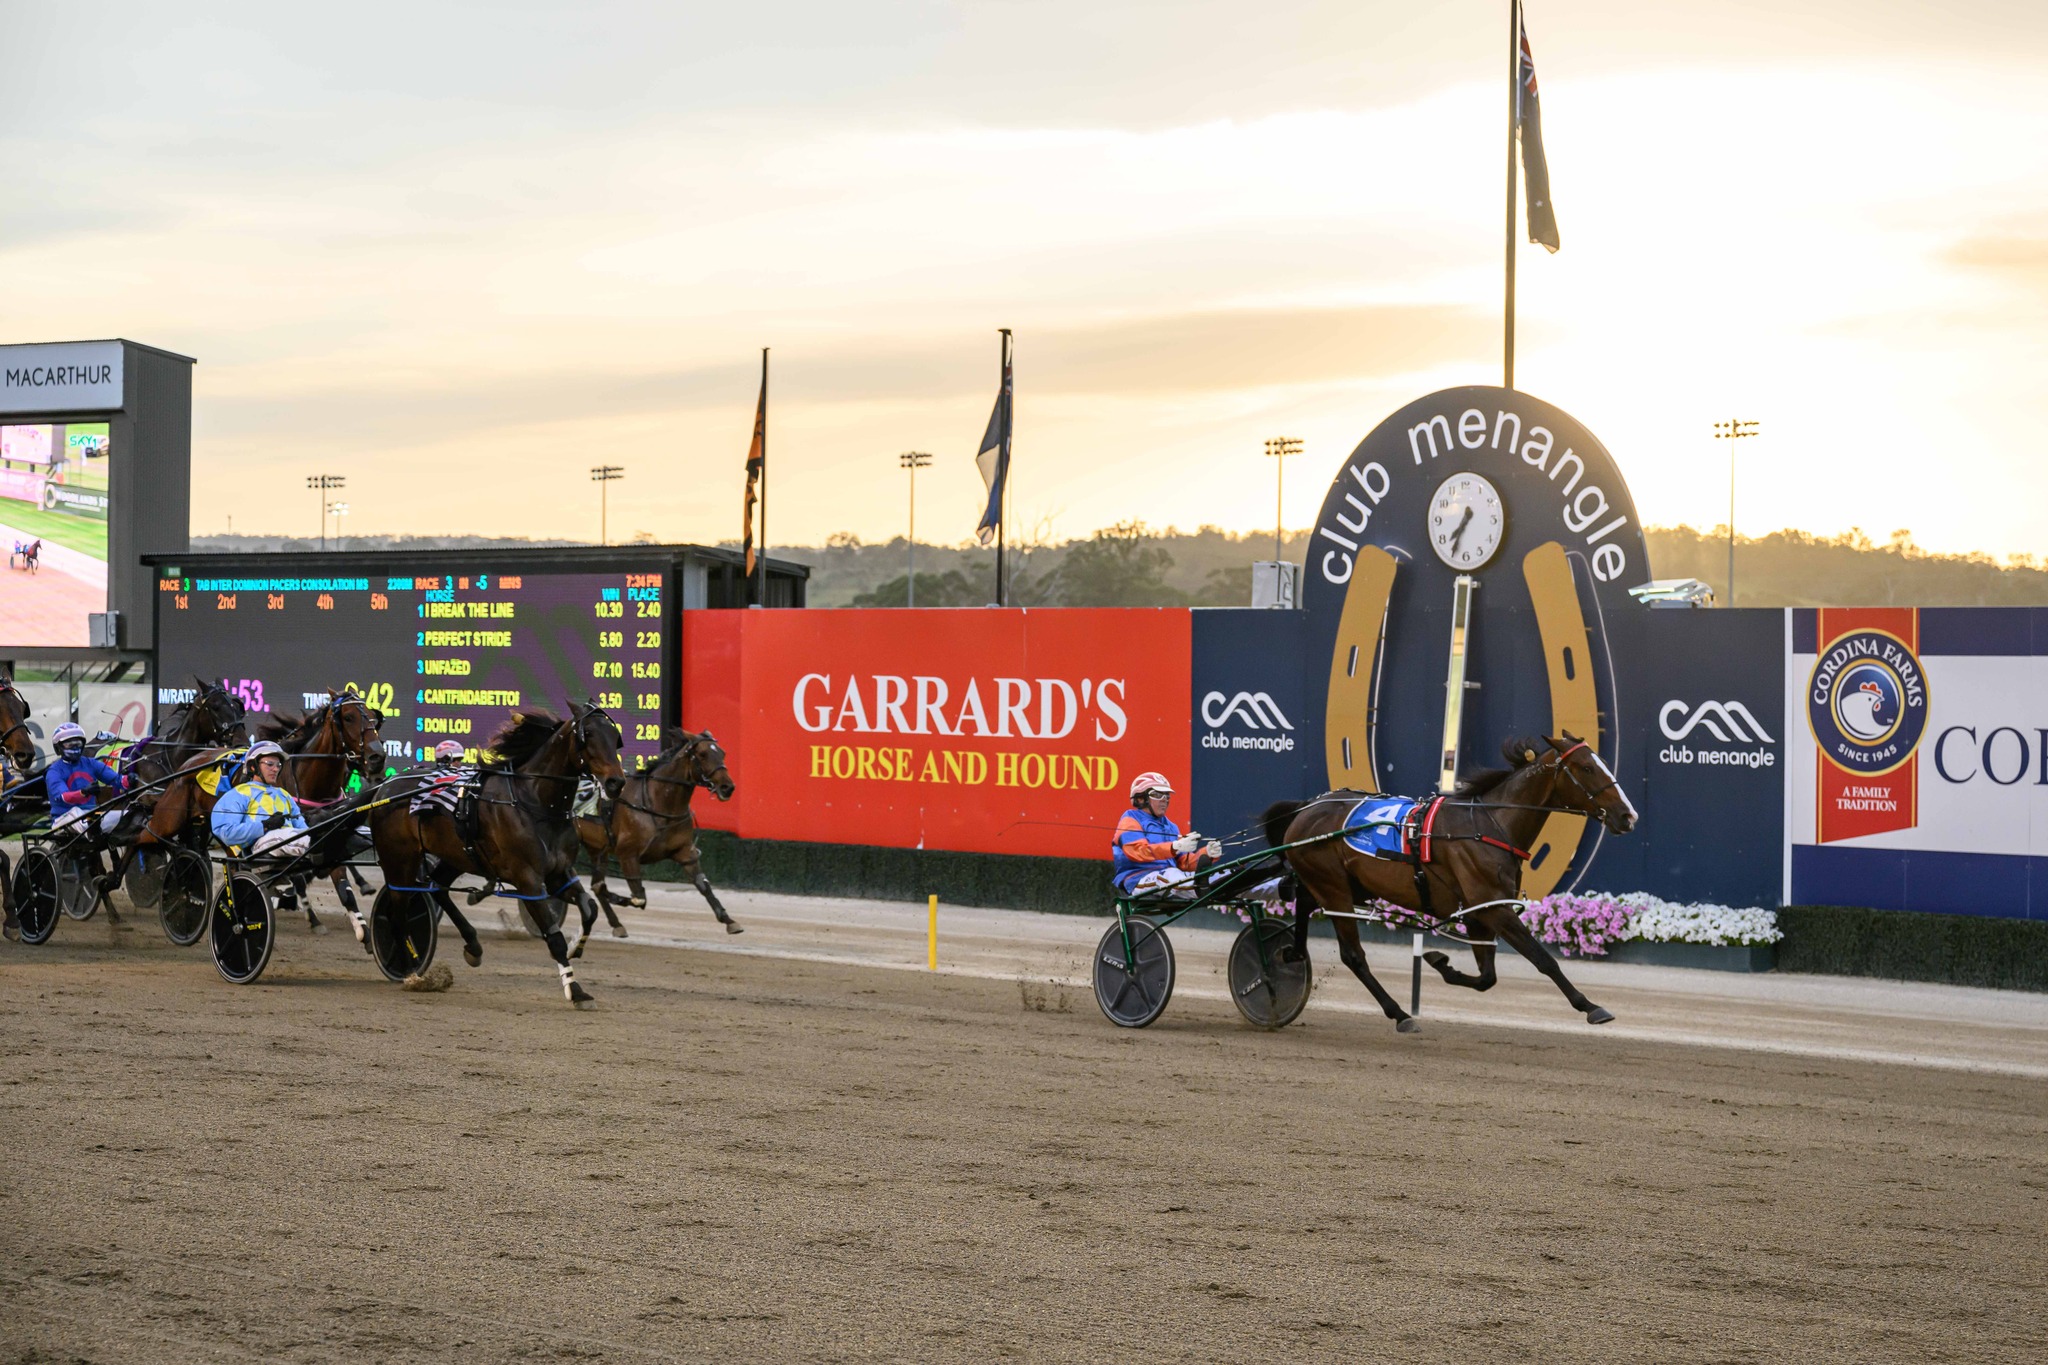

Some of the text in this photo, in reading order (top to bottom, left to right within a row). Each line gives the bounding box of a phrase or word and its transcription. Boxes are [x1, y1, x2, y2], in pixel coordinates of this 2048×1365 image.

[6, 365, 112, 387] MACARTHUR
[1321, 408, 1628, 585] club menangle
[1434, 516, 1442, 526] 9
[1438, 534, 1446, 545] 8
[1462, 551, 1470, 561] 6
[160, 579, 180, 591] RACE
[184, 578, 190, 592] 3
[196, 579, 210, 590] TAB
[210, 579, 232, 591] INTER
[270, 579, 300, 590] PACERS
[301, 578, 355, 590] CONSOLATION
[415, 577, 439, 590] RACE
[445, 576, 453, 590] 3
[475, 575, 488, 590] -5
[174, 594, 389, 609] 1st 2nd 3rd 4th 5th
[425, 589, 455, 602] HORSE
[602, 588, 660, 601] WIN PLACE
[418, 604, 424, 618] 1
[431, 603, 466, 618] BREAK
[467, 603, 489, 618] THE
[490, 603, 515, 618] LINE
[595, 602, 623, 618] 10.30
[637, 602, 661, 618] 2.40
[417, 632, 661, 648] 2 PERFECT STRIDE 5.80 2.20
[417, 659, 661, 678] 3 UNFAZED 87.10 15.40
[1814, 638, 1923, 708] CORDINA FARMS
[416, 690, 424, 704] 4
[599, 693, 623, 709] 3.50
[637, 694, 661, 710] 1.80
[792, 673, 1127, 742] GARRARD'S
[416, 718, 424, 732] 5
[425, 718, 447, 733] DON
[449, 719, 471, 734] LOU
[636, 724, 660, 740] 2.80
[384, 740, 402, 757] TR
[403, 741, 412, 757] 4
[1201, 731, 1295, 753] club menangle
[416, 748, 424, 762] 6
[1659, 744, 1775, 769] club menangle
[1837, 743, 1898, 763] SINCE 1945
[809, 744, 1119, 792] HORSE AND HOUND
[1842, 786, 1891, 798] A FAMILY
[1835, 798, 1897, 812] TRADITION
[1364, 804, 1402, 836] 4
